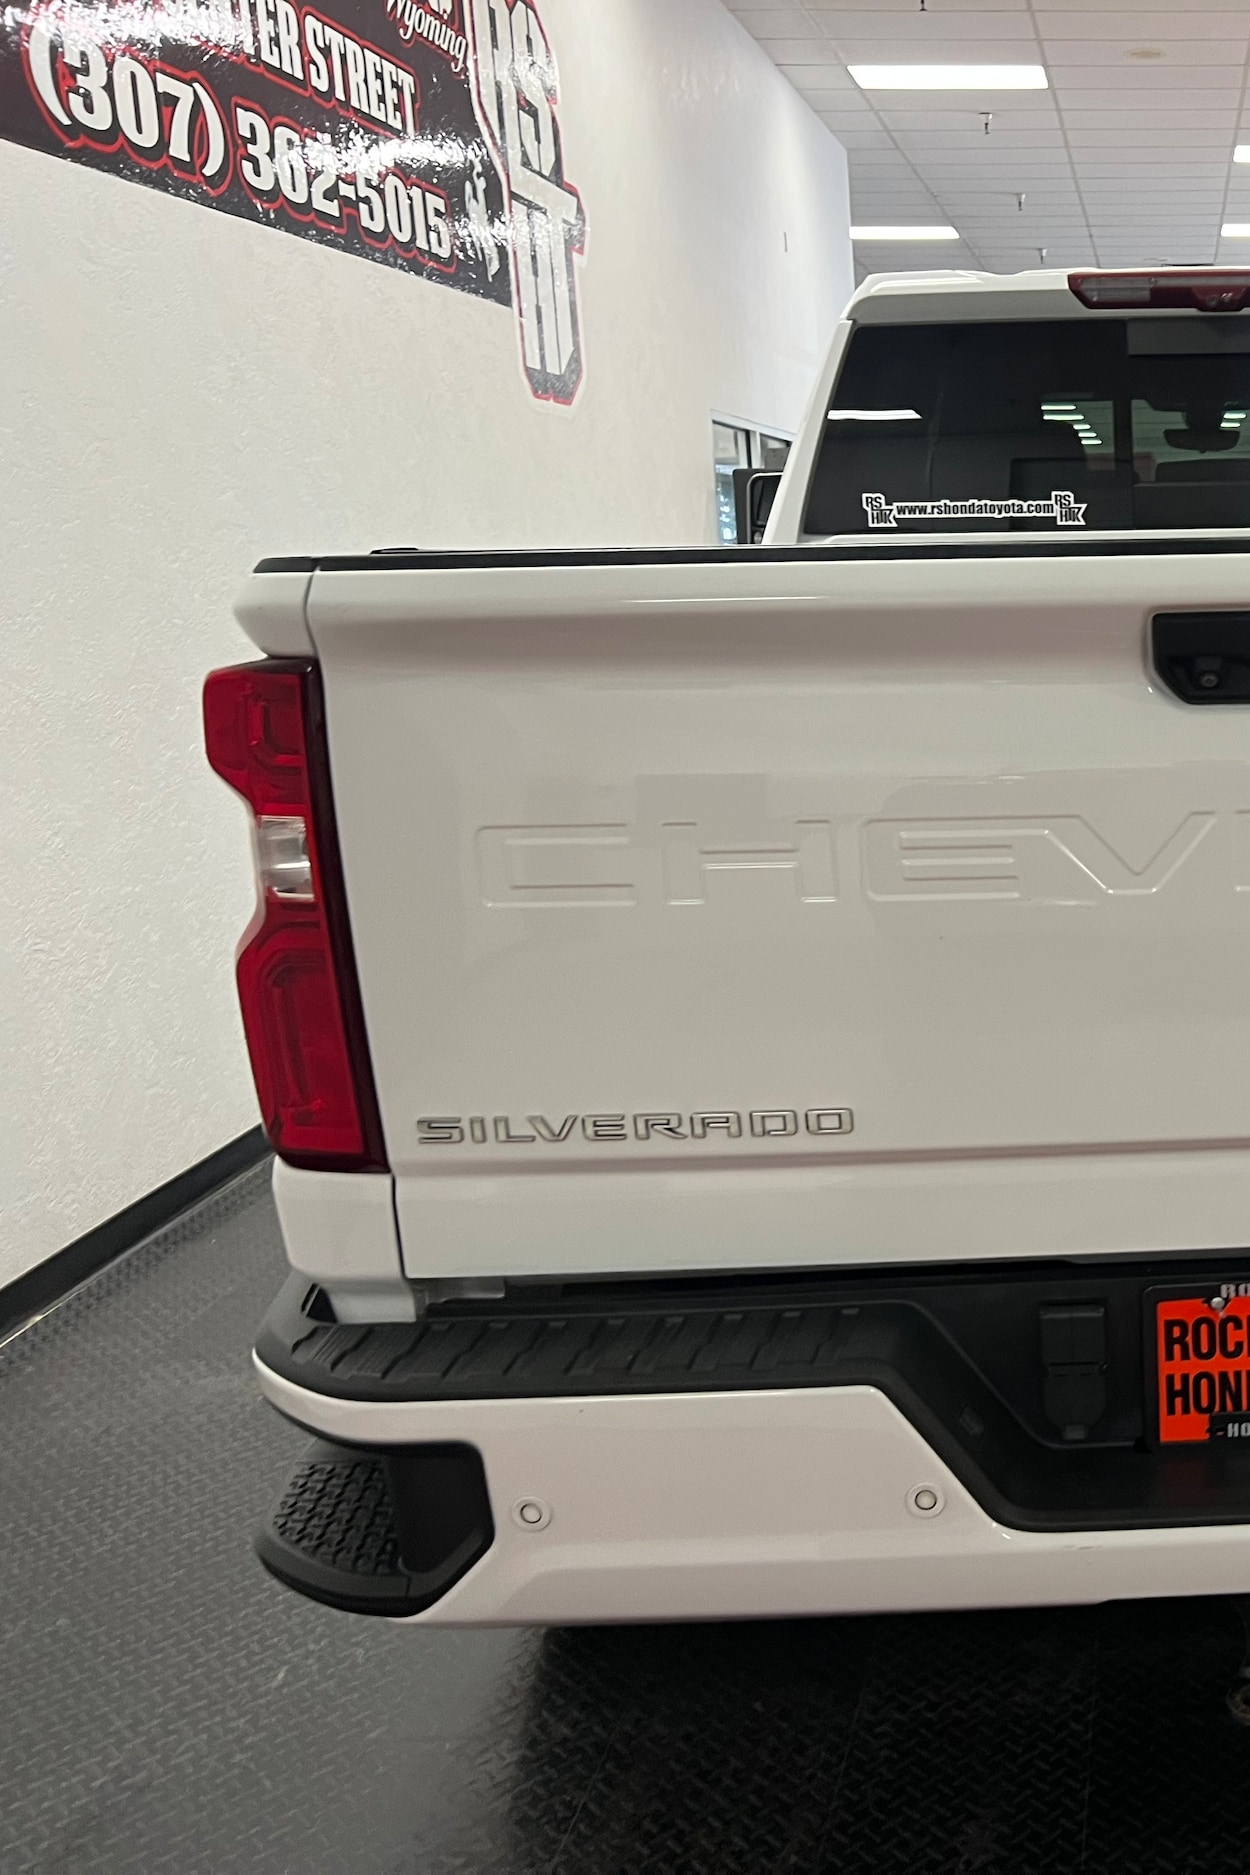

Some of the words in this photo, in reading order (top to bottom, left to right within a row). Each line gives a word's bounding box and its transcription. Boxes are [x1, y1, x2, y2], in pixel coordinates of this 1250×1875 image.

[28, 20, 225, 177] (307)
[304, 14, 415, 136] STREET
[896, 500, 1055, 517] www.rshondatoyota.com
[416, 1107, 855, 1145] SILVERADO
